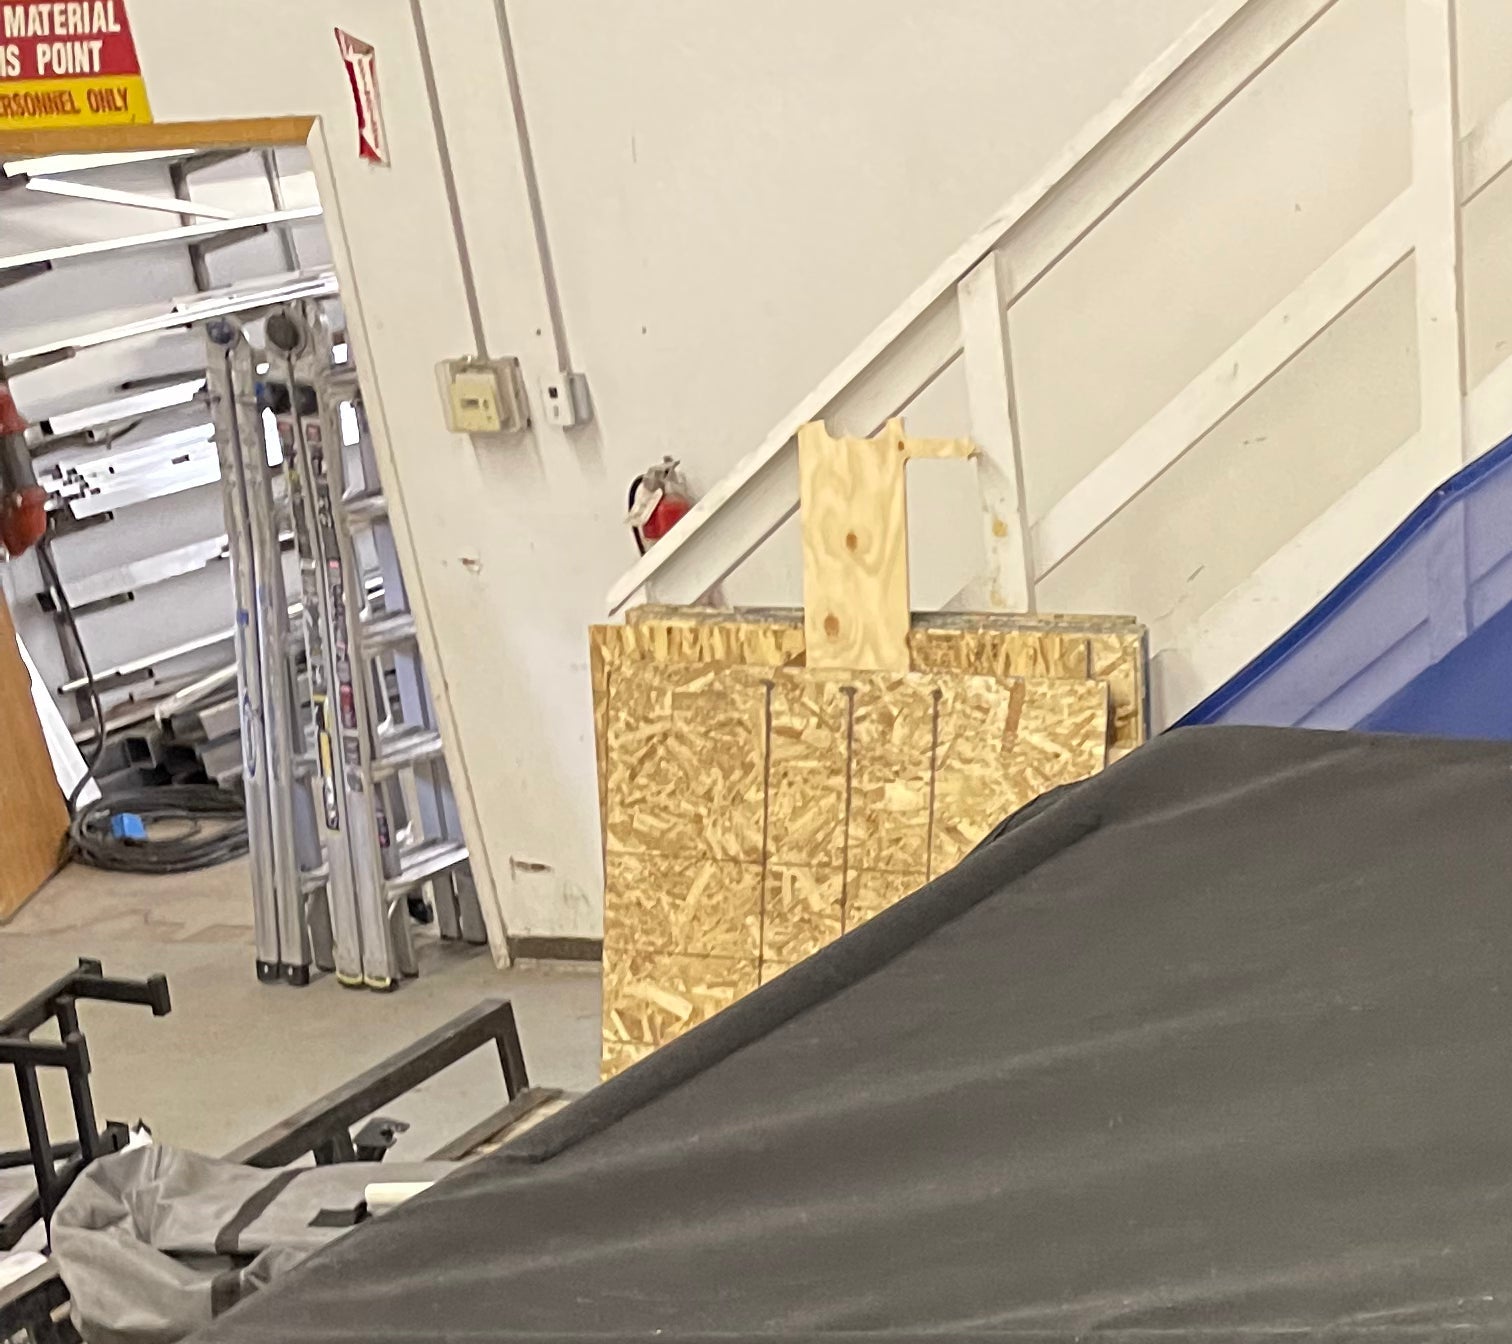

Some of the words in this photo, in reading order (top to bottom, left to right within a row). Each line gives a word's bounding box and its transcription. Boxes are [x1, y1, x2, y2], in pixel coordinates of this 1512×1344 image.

[3, 0, 121, 38] MATERIAL
[0, 44, 21, 77] IS
[36, 40, 103, 75] POINT
[86, 87, 129, 113] ONLY
